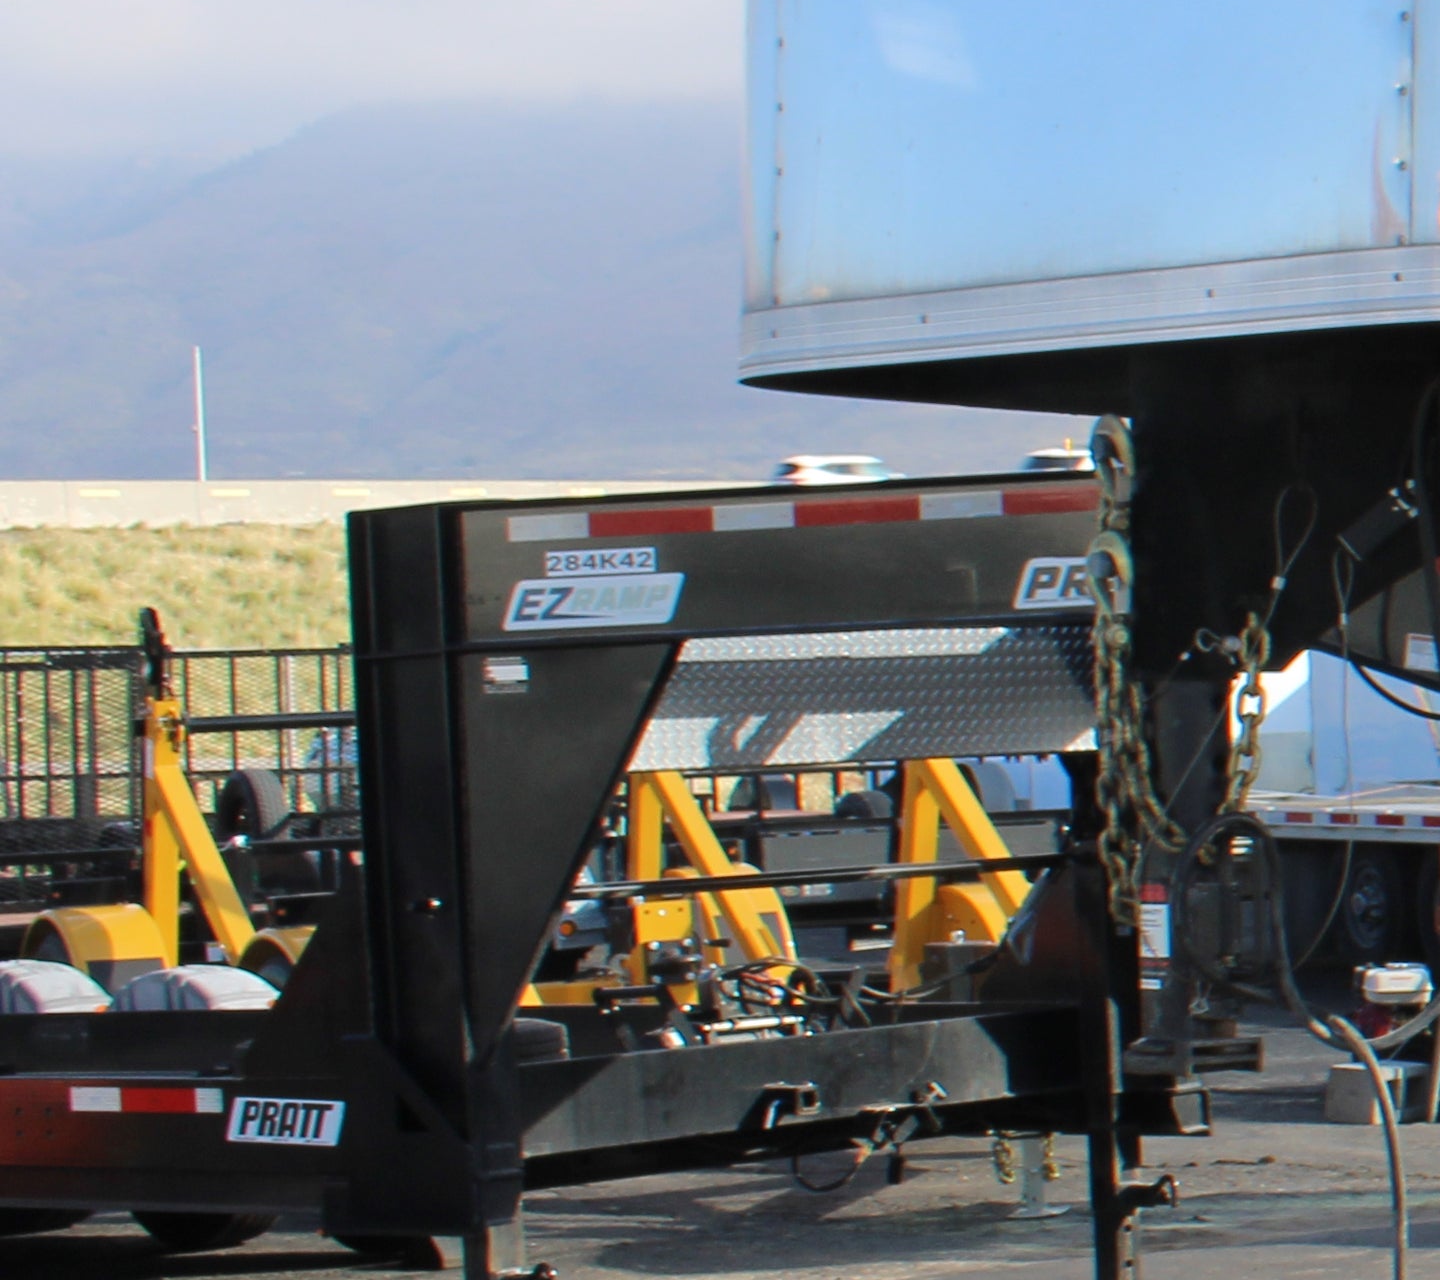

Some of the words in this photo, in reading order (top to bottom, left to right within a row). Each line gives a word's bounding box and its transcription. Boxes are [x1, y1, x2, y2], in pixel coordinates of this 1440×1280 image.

[547, 551, 654, 572] 284K42
[1023, 565, 1091, 600] PR
[239, 1100, 334, 1139] PRATT
